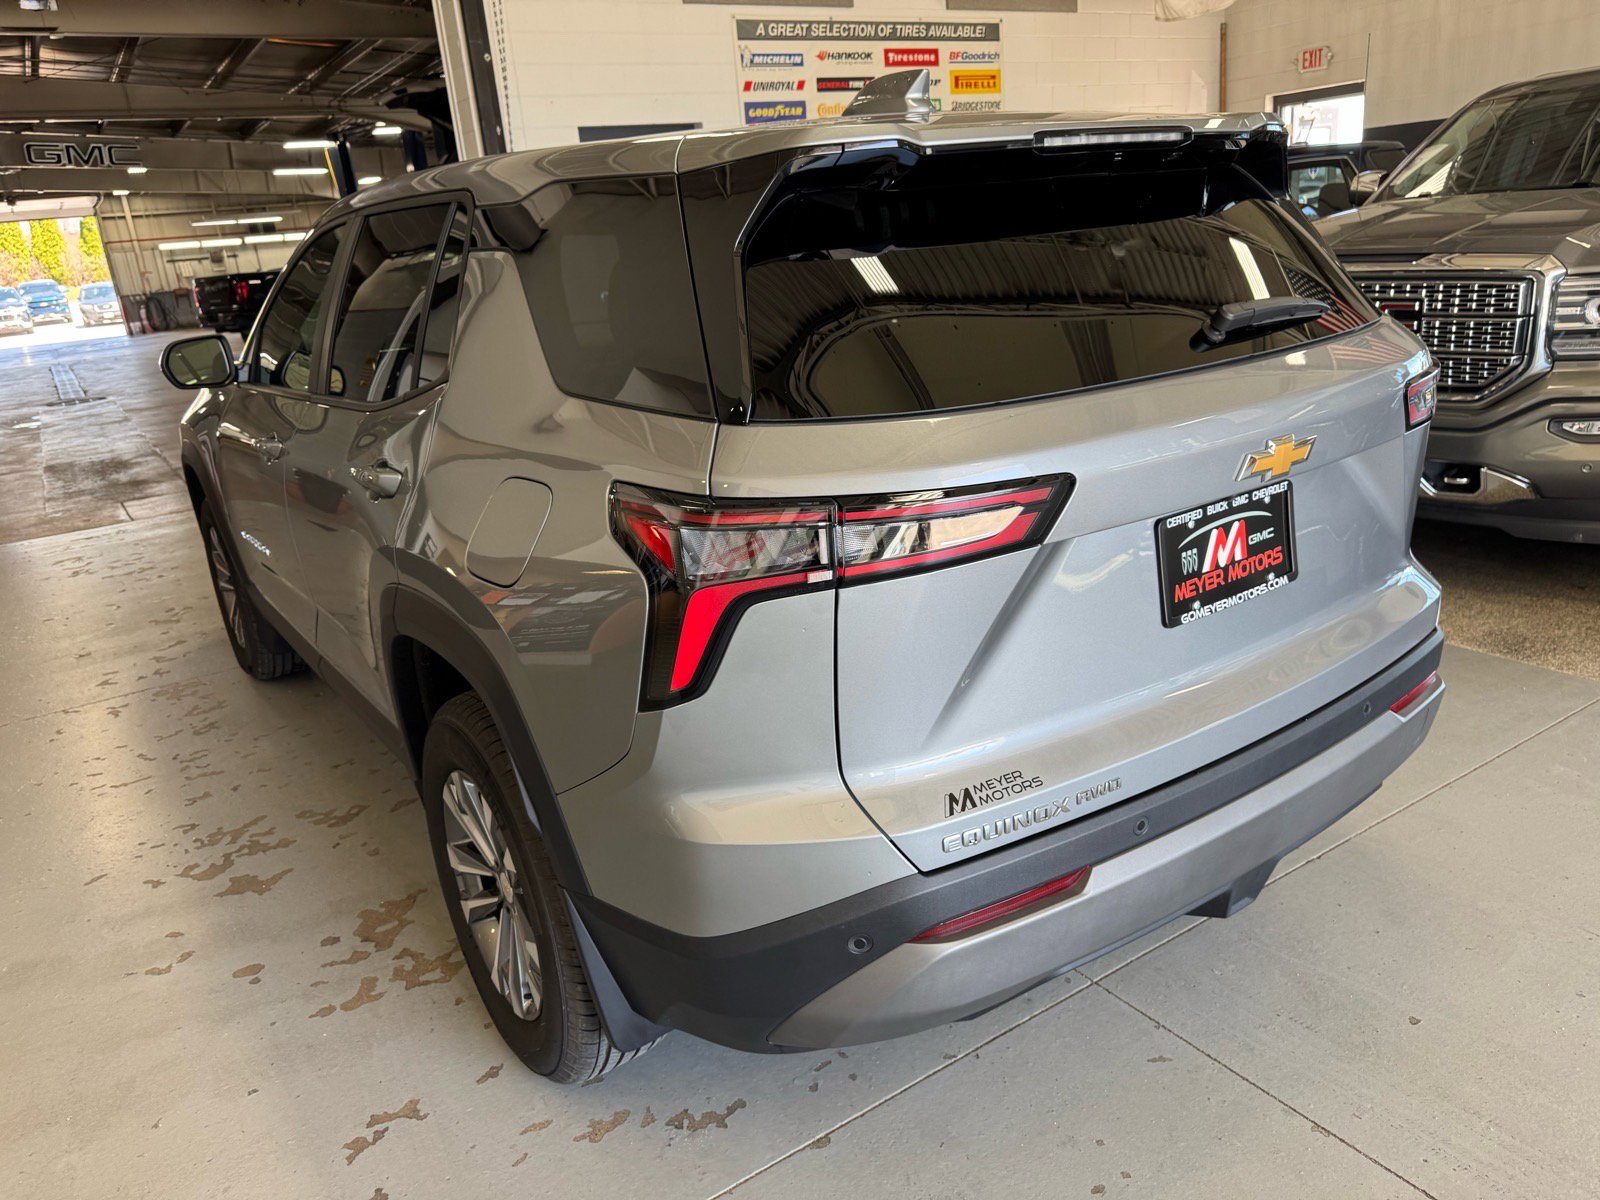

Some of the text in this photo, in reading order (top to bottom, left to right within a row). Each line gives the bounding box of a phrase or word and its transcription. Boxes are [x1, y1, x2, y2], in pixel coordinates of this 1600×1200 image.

[756, 23, 986, 38] A GREAT SELECTION OF TIRES AVAILABLE!
[752, 55, 802, 64] MICHELIN
[887, 52, 936, 64] Firestone
[949, 51, 1000, 60] BFGoodrich
[1302, 48, 1323, 70] EXIT
[753, 81, 796, 92] UNIROYAL
[954, 75, 996, 89] PIRELLI
[951, 100, 1002, 112] BRIDGESTONE
[24, 142, 143, 167] GMC
[1166, 481, 1289, 529] CERTIFIED BUICK GMC CHEVROLET
[1248, 527, 1275, 545] GMC
[1174, 546, 1284, 603] MEYER MOTORS
[1180, 575, 1289, 624] GOMEYERMOTORS.COM
[973, 770, 1024, 794] MEYER
[979, 776, 1044, 806] MOTORS
[942, 777, 1122, 854] EQUINOX AWD
